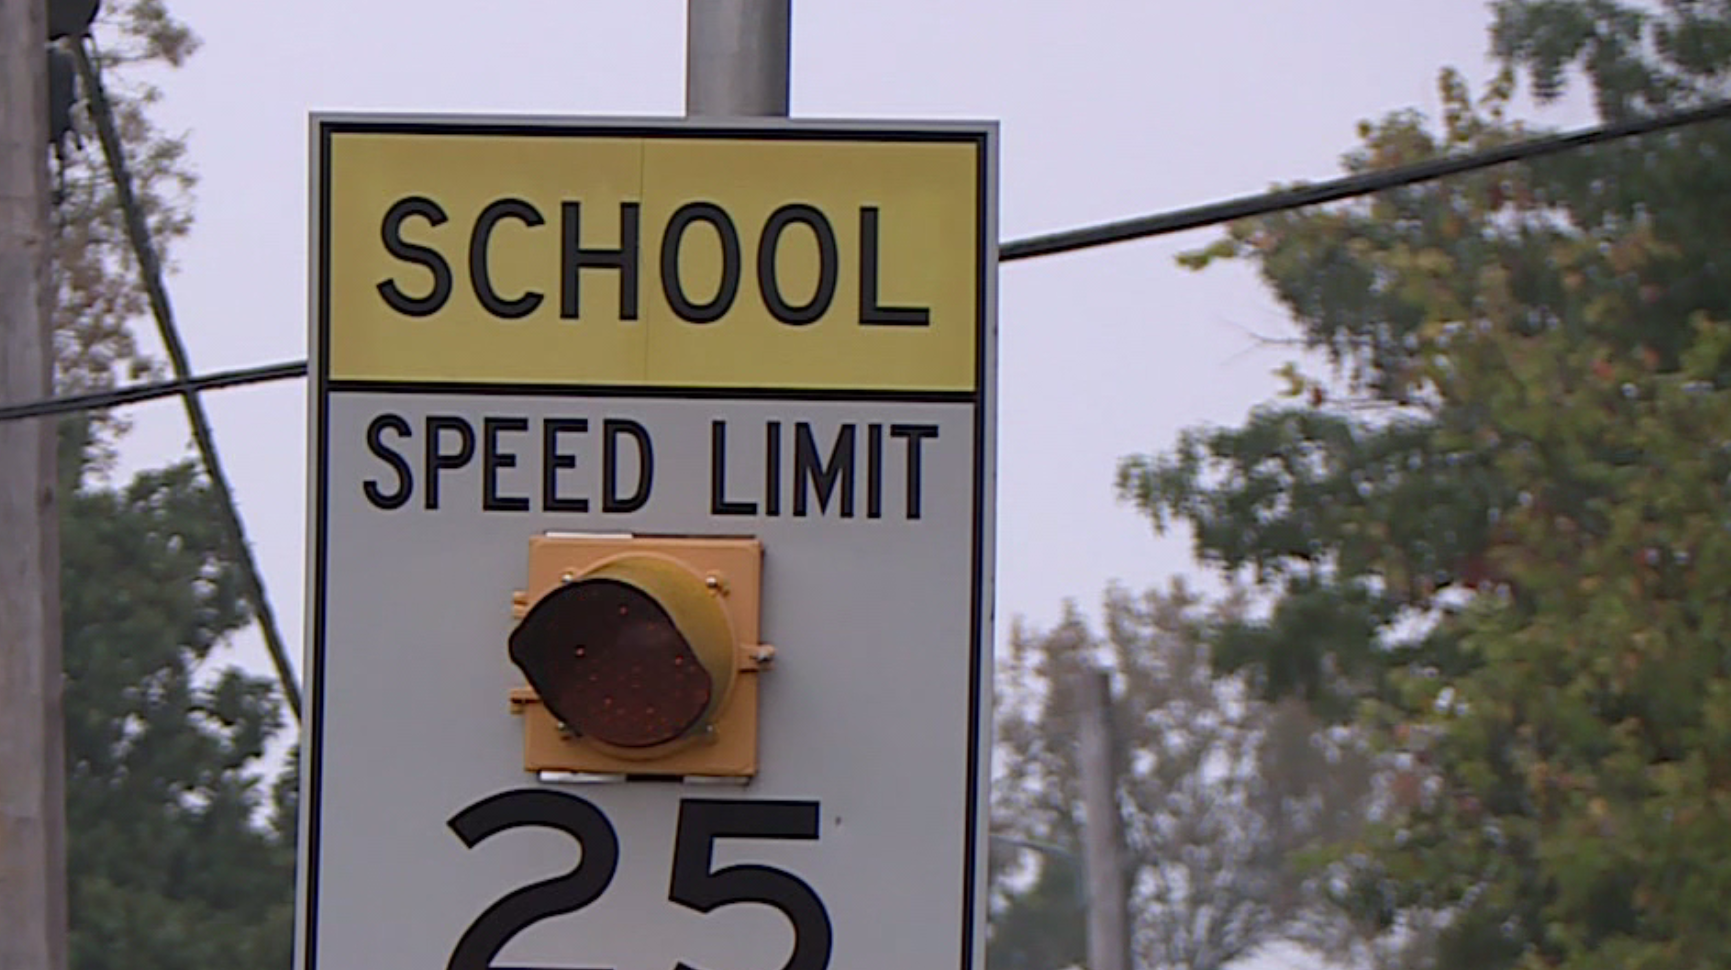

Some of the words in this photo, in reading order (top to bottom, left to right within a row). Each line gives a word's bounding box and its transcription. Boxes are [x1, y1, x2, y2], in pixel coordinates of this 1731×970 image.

[375, 195, 931, 327] SCHOOL
[362, 413, 655, 514] SPEED
[710, 419, 940, 520] LIMIT
